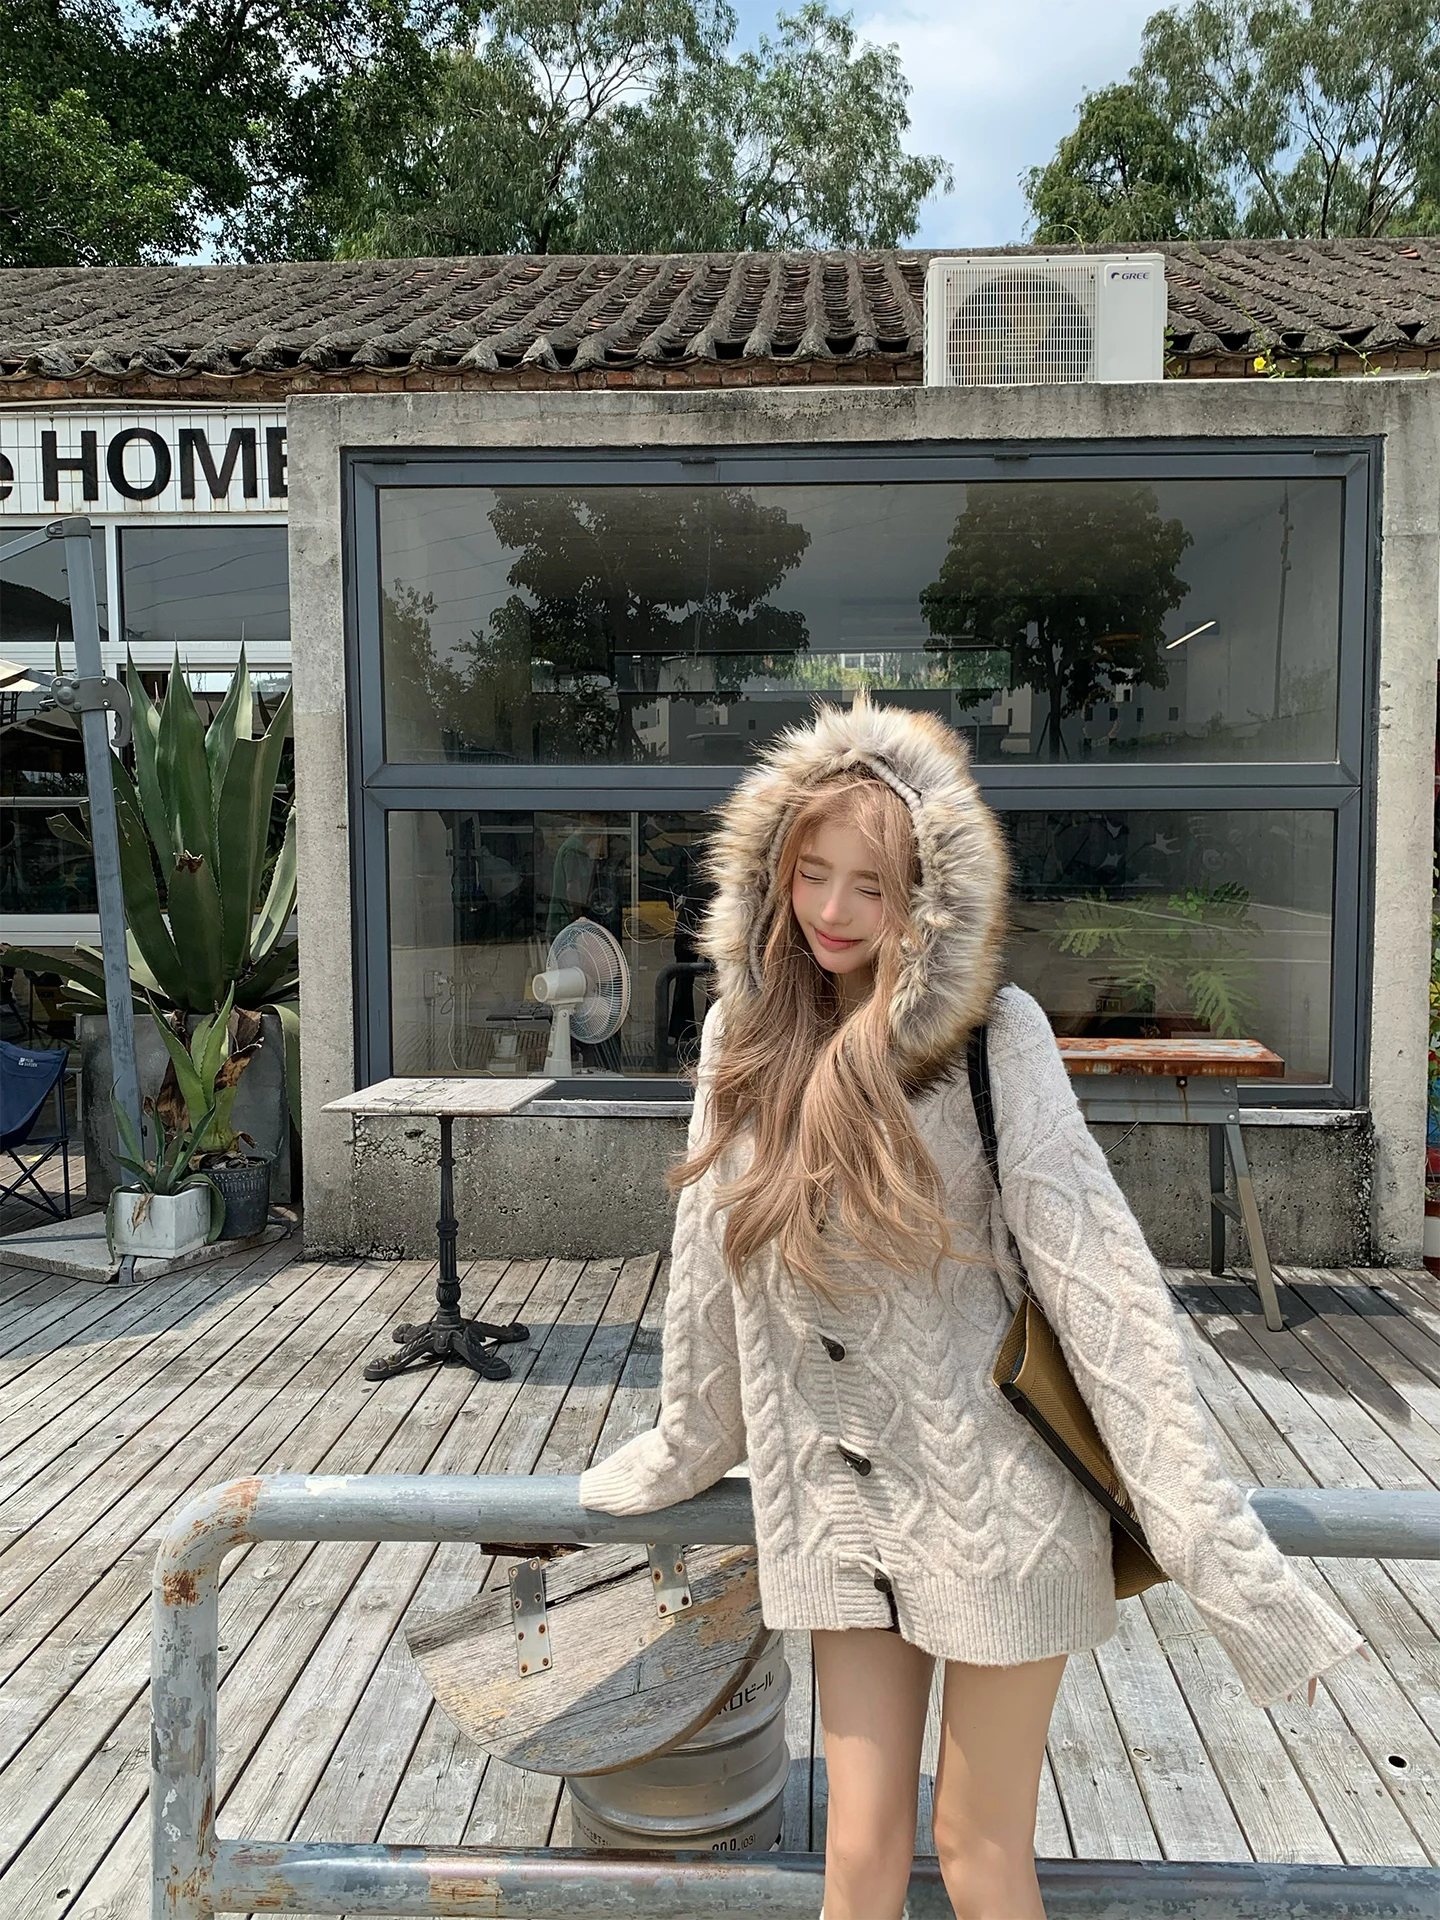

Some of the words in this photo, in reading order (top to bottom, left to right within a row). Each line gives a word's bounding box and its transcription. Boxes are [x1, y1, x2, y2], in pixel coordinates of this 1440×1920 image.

[1121, 271, 1150, 280] GREE
[718, 1671, 775, 1715] ロビール
